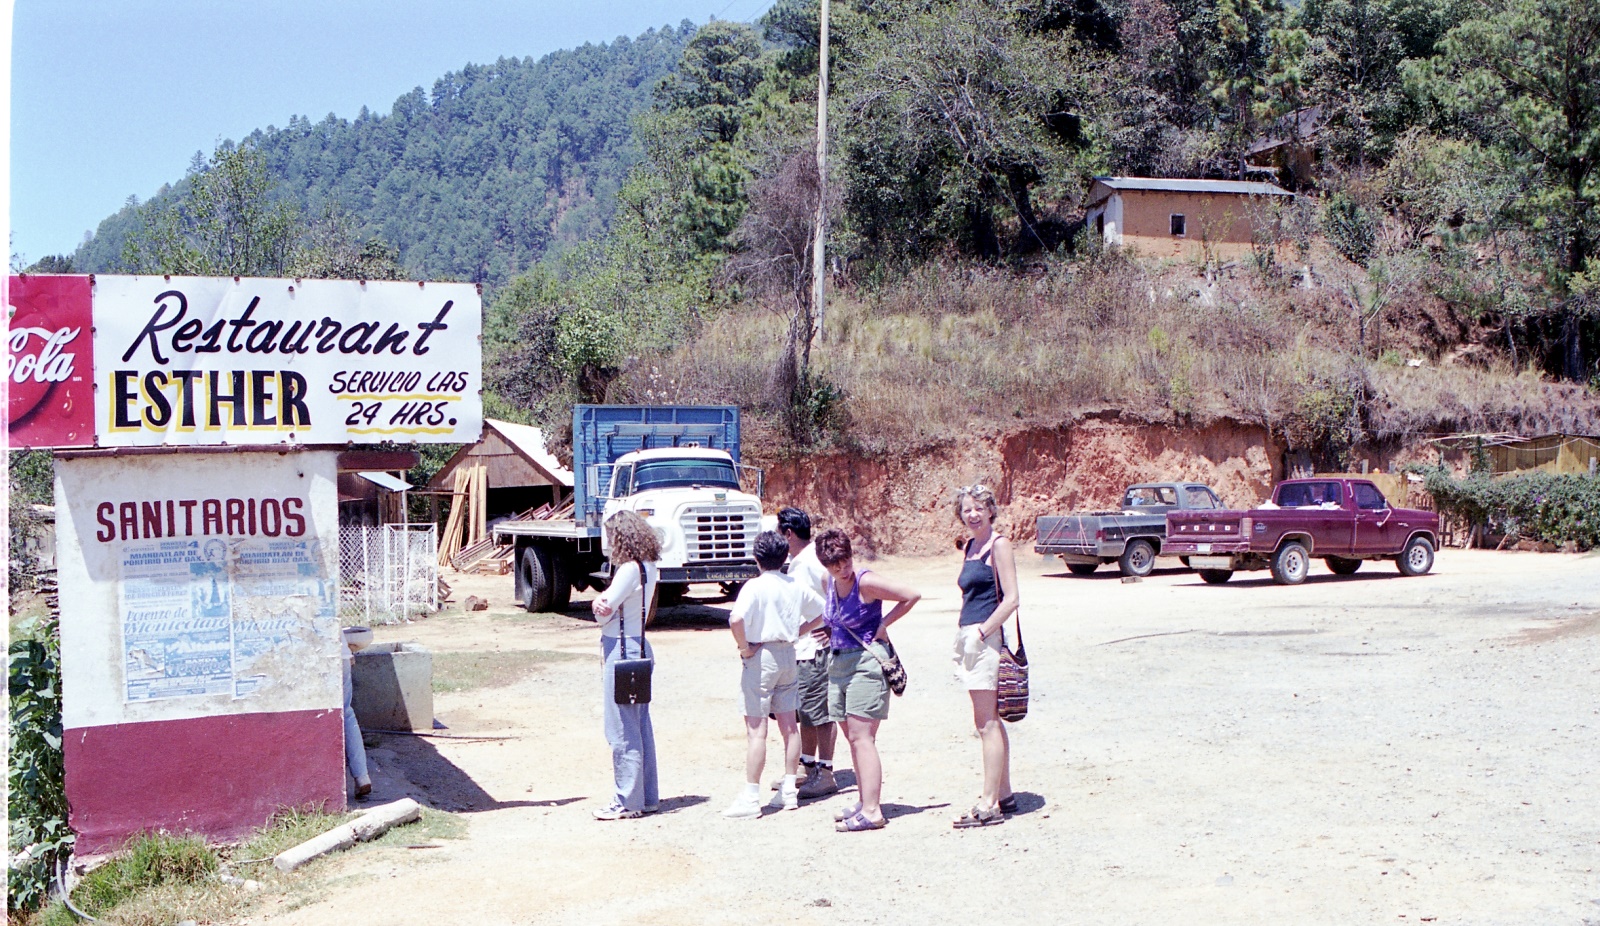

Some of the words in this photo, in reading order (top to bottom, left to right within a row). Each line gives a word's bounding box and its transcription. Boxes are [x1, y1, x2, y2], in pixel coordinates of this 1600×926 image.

[122, 290, 453, 365] Restaurant
[329, 370, 419, 394] SERVICIO
[426, 371, 469, 392] LAS
[109, 369, 312, 432] ESTHER
[346, 402, 377, 426] 24
[389, 401, 457, 426] HRS.
[96, 497, 306, 543] SANITARIOS
[296, 541, 307, 549] 4
[124, 559, 162, 567] PORFIRIO
